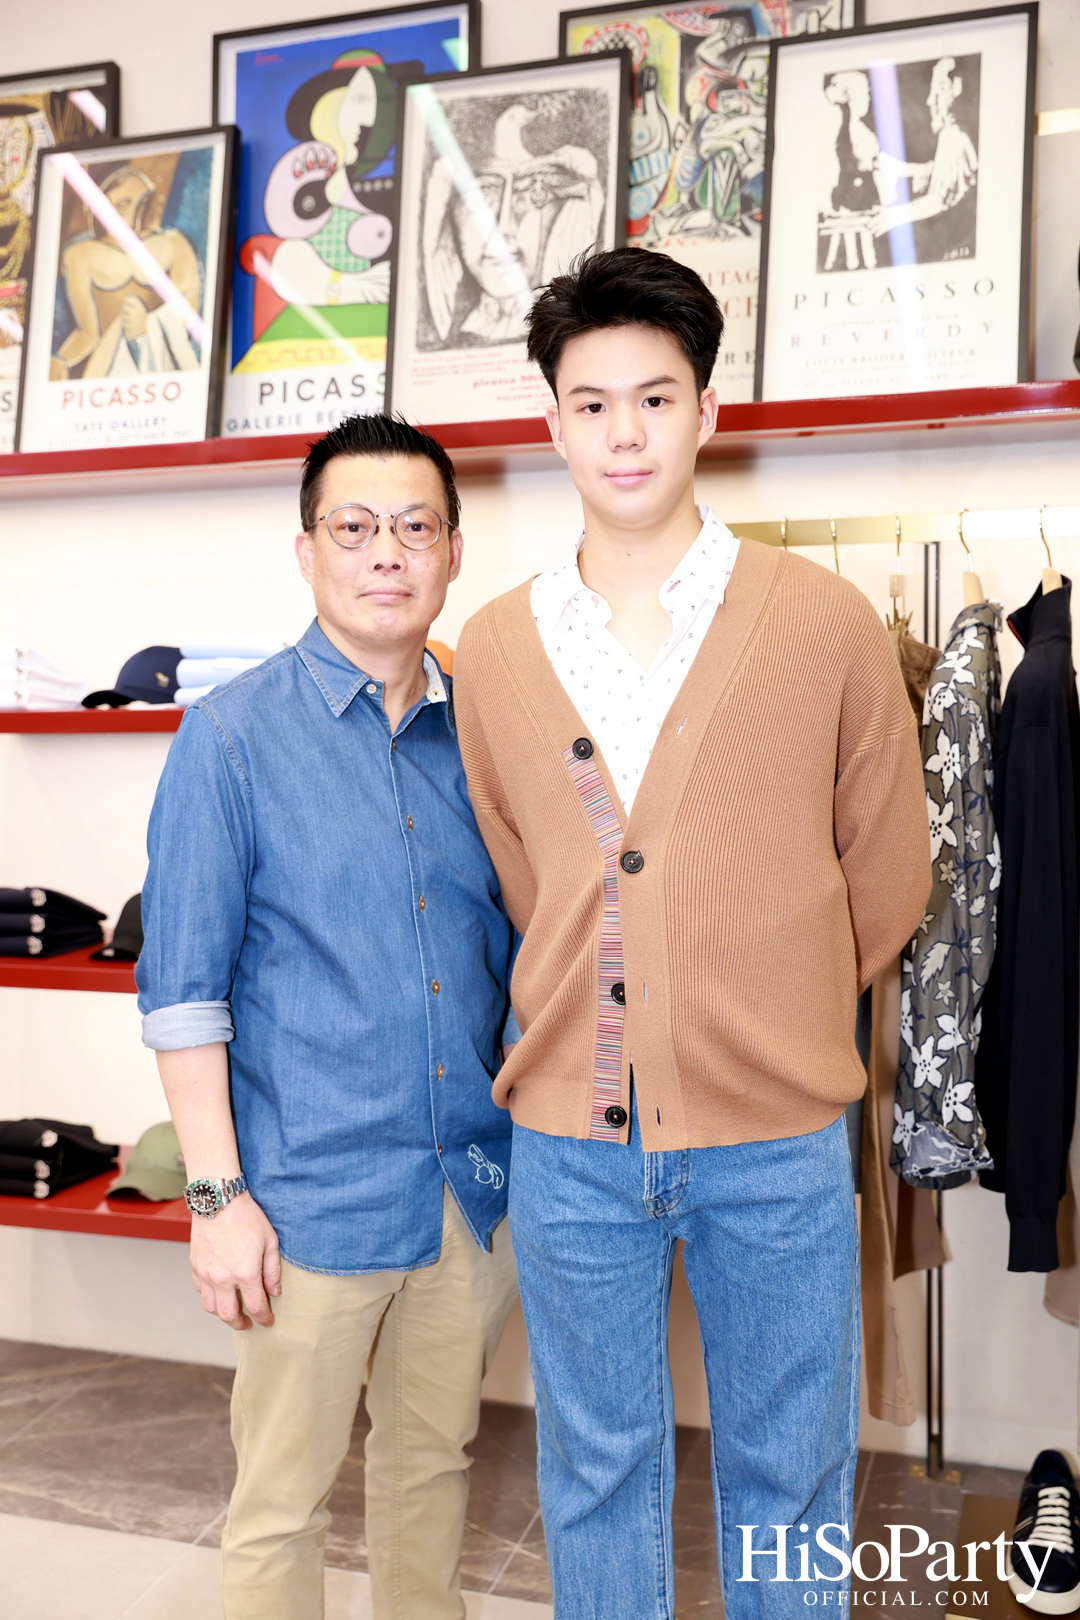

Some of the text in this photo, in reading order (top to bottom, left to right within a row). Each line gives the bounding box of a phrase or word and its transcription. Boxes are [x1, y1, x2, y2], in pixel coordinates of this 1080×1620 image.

[793, 277, 995, 310] PICASSO
[791, 321, 993, 348] REVERDY
[62, 381, 182, 409] PICASSO
[226, 413, 304, 433] GALERIE
